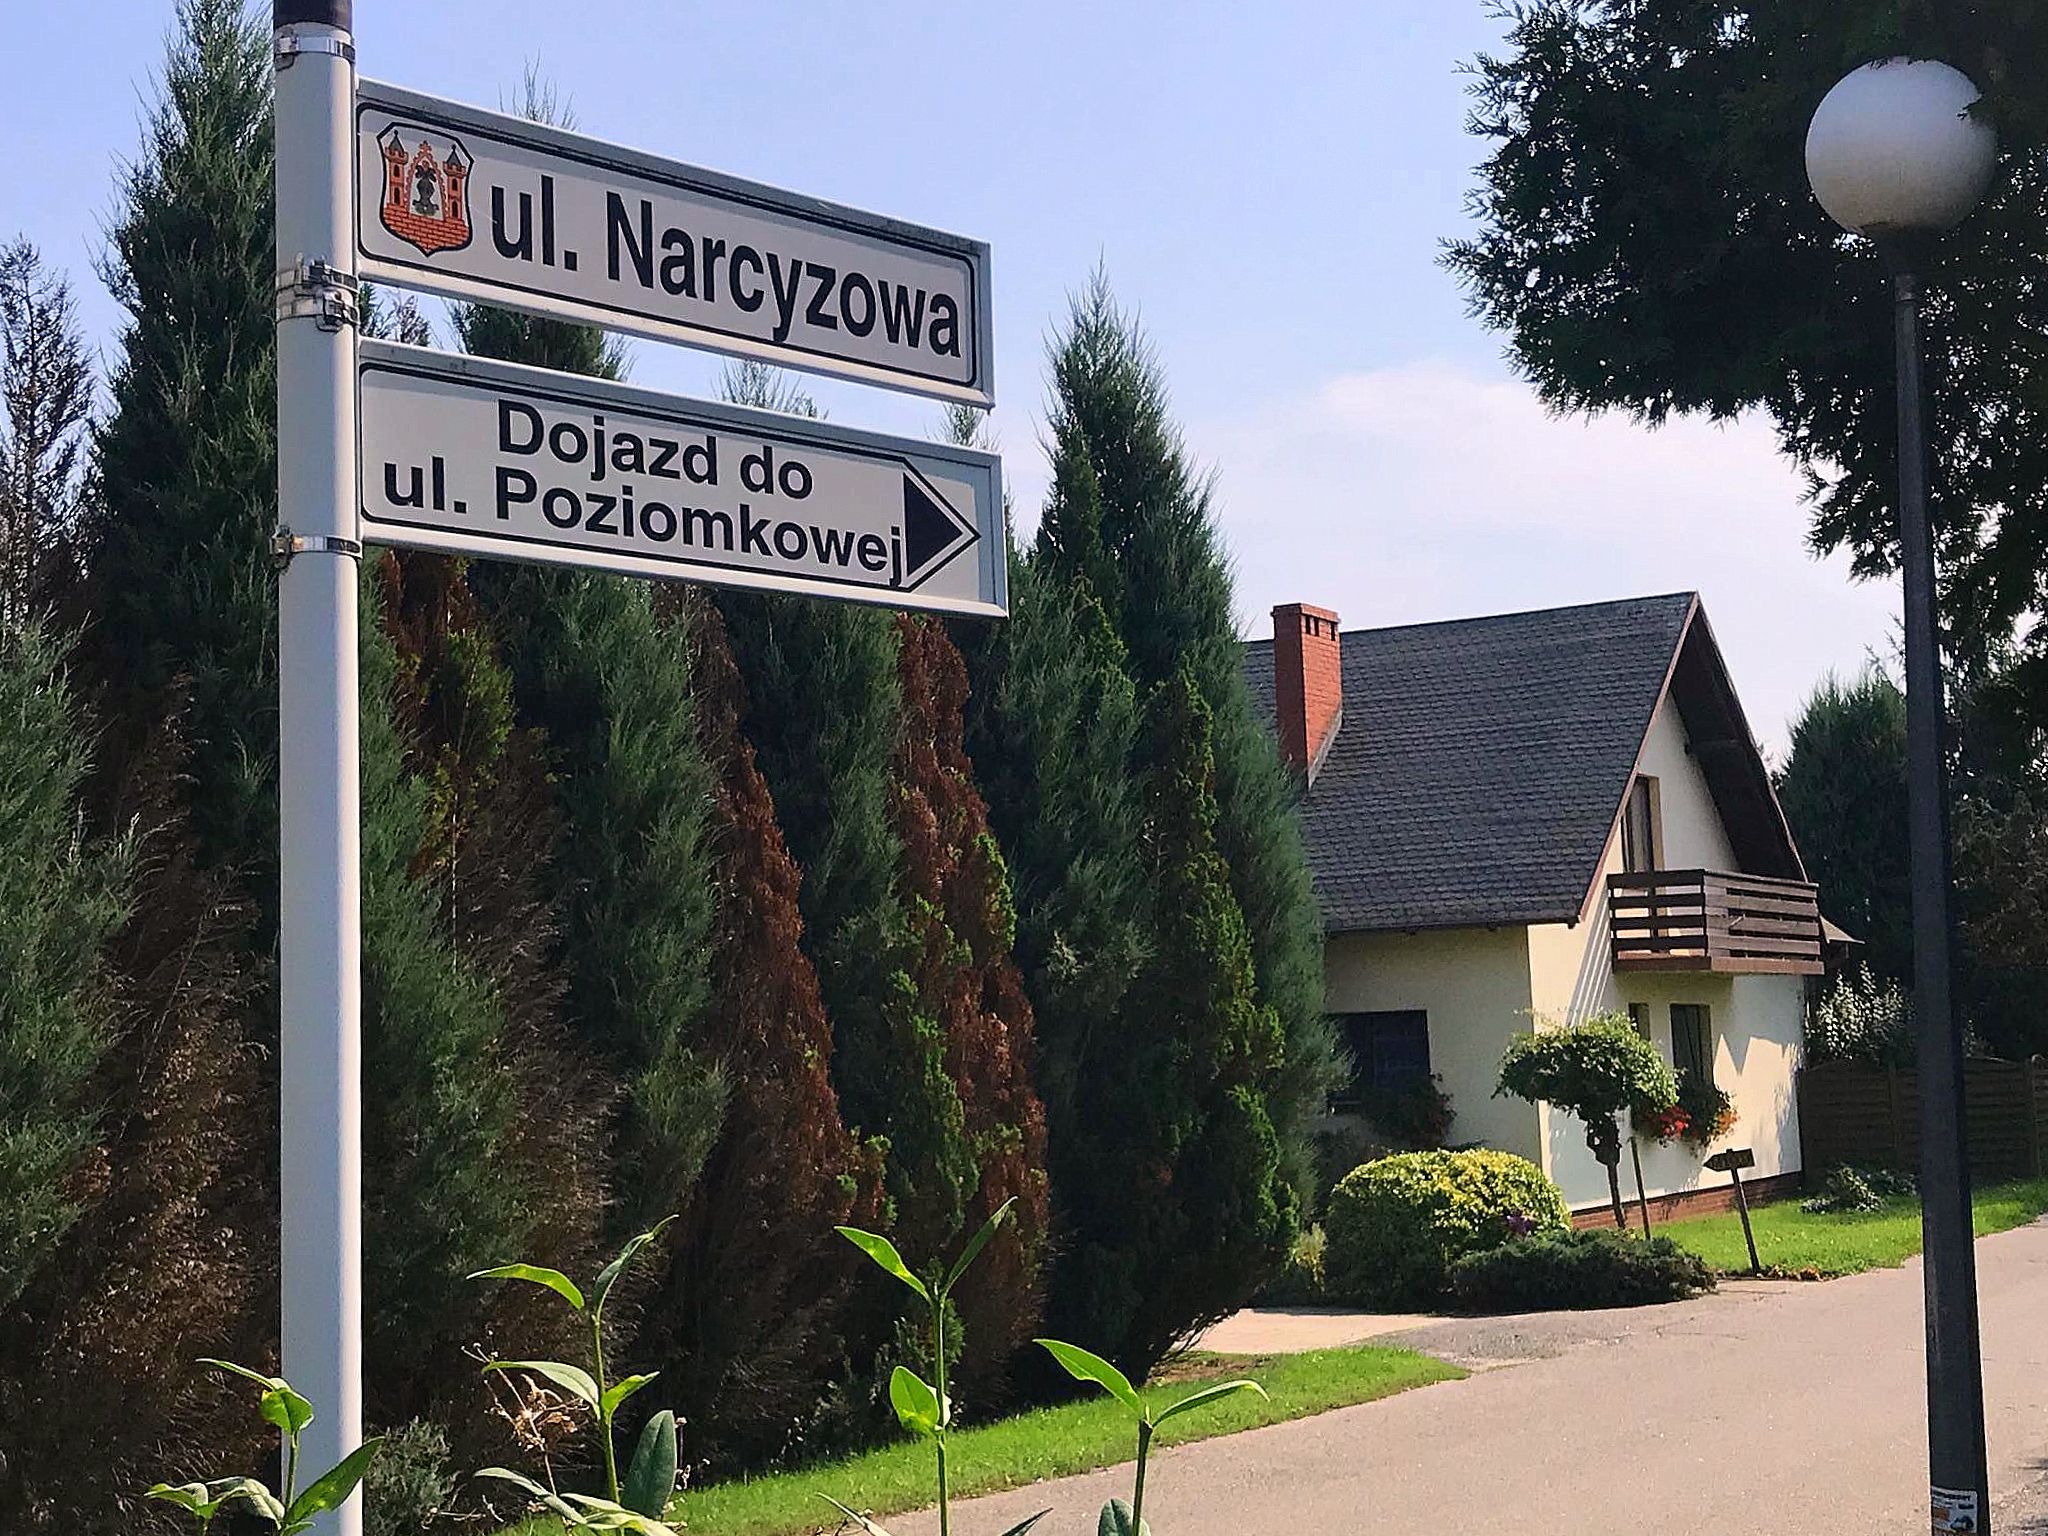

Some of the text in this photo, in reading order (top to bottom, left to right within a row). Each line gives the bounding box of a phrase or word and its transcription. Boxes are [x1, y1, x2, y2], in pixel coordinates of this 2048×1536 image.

[491, 175, 962, 358] ul. Narcyzowa
[499, 399, 814, 499] Dojazd do
[384, 456, 902, 587] ul. Poziomkowej
